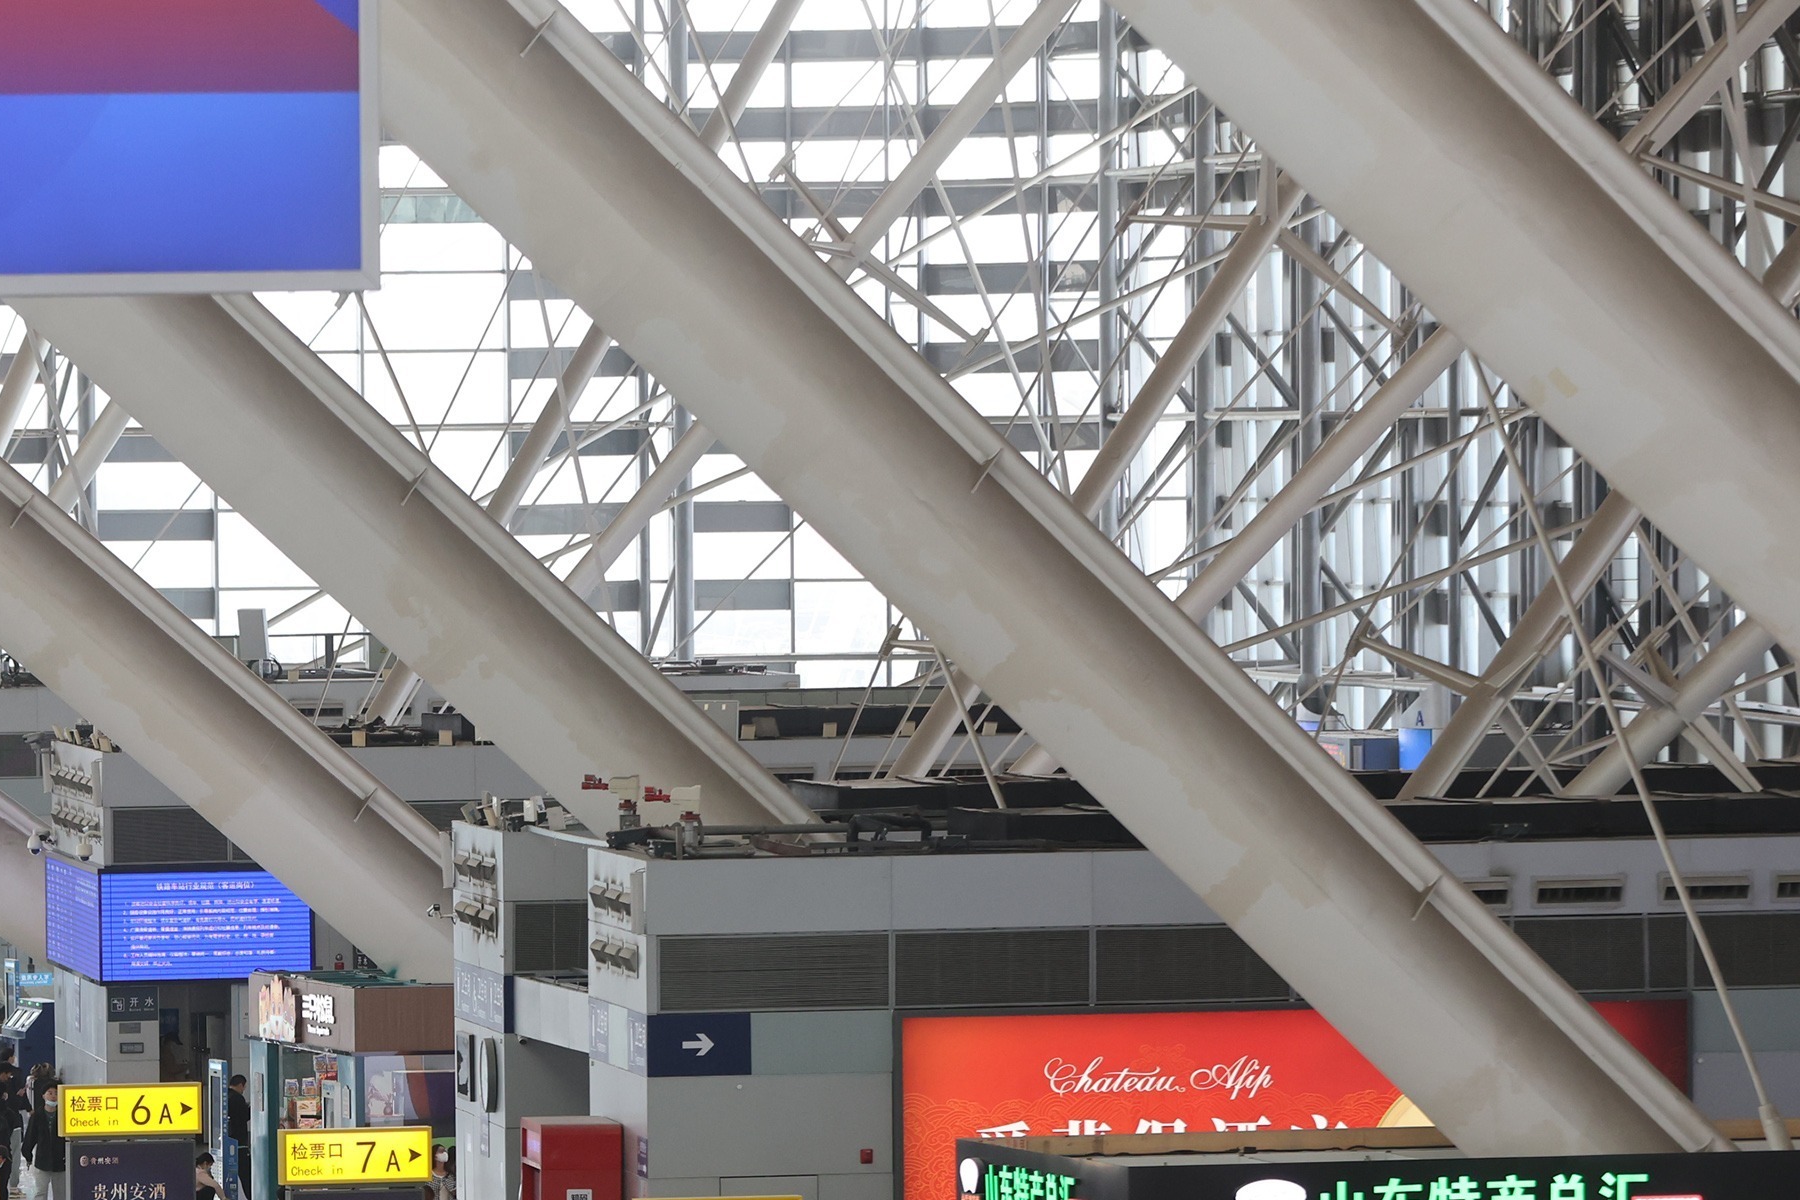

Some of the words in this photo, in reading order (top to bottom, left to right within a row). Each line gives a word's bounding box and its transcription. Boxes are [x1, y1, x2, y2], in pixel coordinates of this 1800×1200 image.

[1044, 1056, 1186, 1098] Chateau
[70, 1095, 119, 1112] 检票口
[131, 1094, 151, 1126] 6
[159, 1103, 173, 1125] A
[70, 1117, 100, 1127] Check
[108, 1116, 119, 1127] in
[291, 1143, 343, 1160] 检票口
[356, 1141, 376, 1174] 7
[386, 1150, 401, 1172] A
[291, 1165, 323, 1177] Check
[332, 1164, 344, 1176] in
